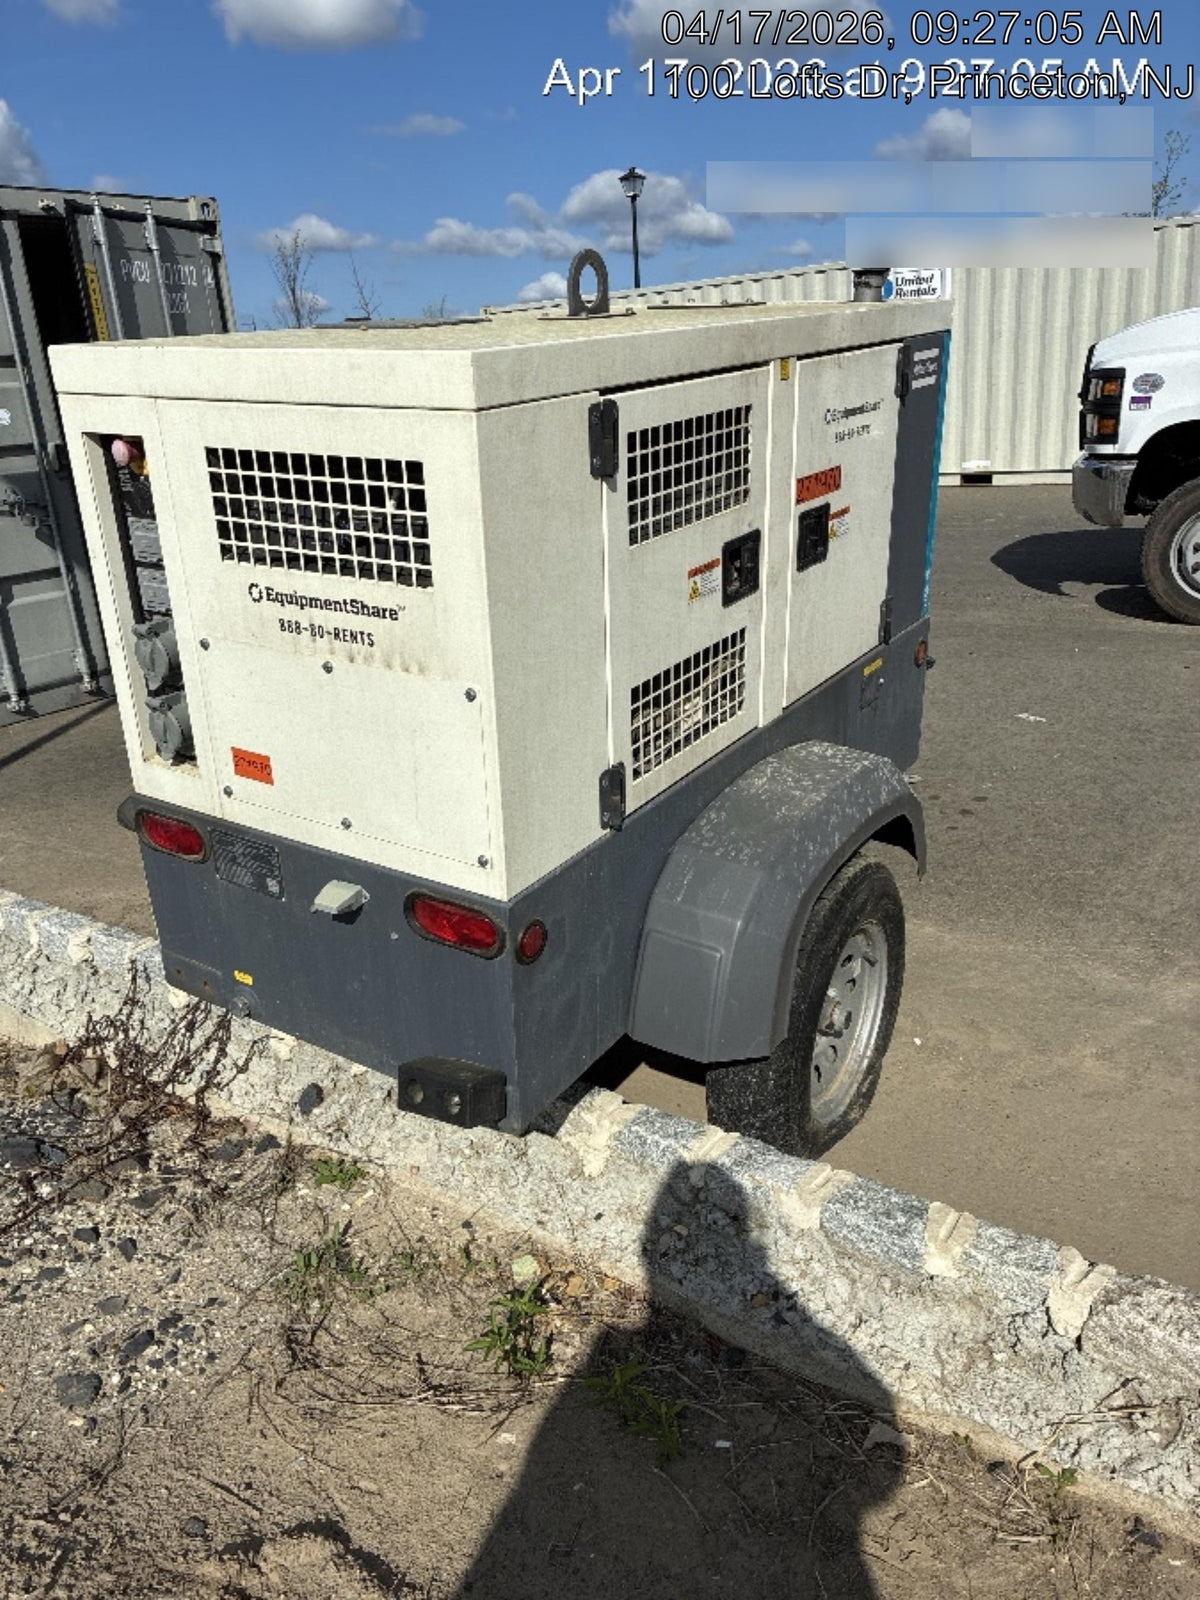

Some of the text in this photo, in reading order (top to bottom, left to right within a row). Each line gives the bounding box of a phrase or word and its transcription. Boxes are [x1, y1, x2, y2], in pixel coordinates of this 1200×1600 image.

[895, 273, 934, 287] United
[895, 285, 938, 299] Rentals
[265, 586, 400, 621] EquipmentShare
[279, 618, 375, 648] 888-80-RENTS
